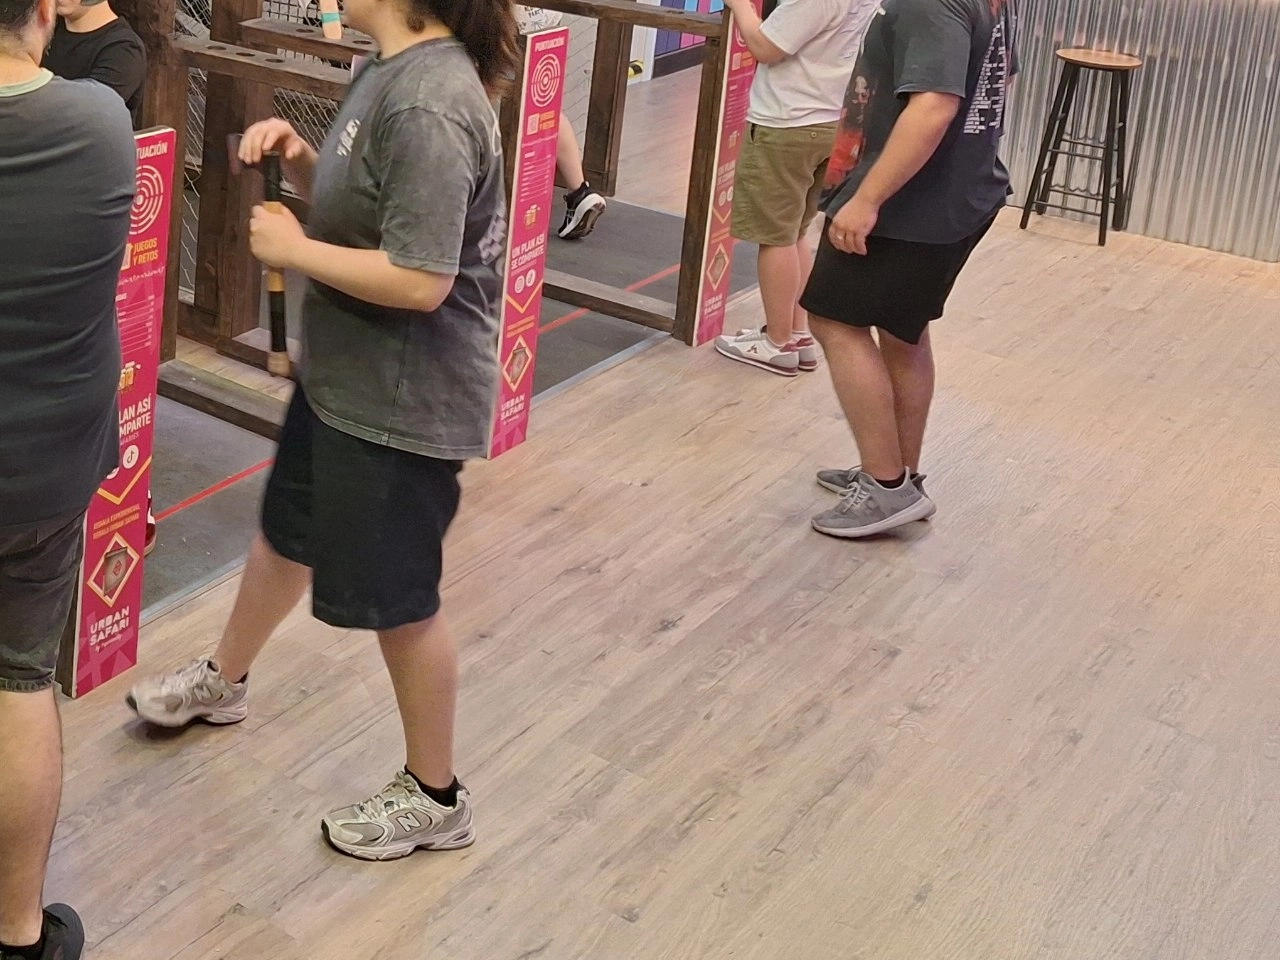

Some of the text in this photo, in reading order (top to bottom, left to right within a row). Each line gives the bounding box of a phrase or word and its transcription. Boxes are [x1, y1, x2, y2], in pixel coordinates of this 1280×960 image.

[136, 140, 168, 159] TUACIÓN
[133, 238, 158, 255] JUEGOS
[133, 250, 159, 266] Y RETOS
[119, 393, 151, 425] LAN ASÍ
[120, 412, 151, 438] MPARTE
[90, 605, 129, 634] URBAN
[90, 616, 129, 646] SAFARI
